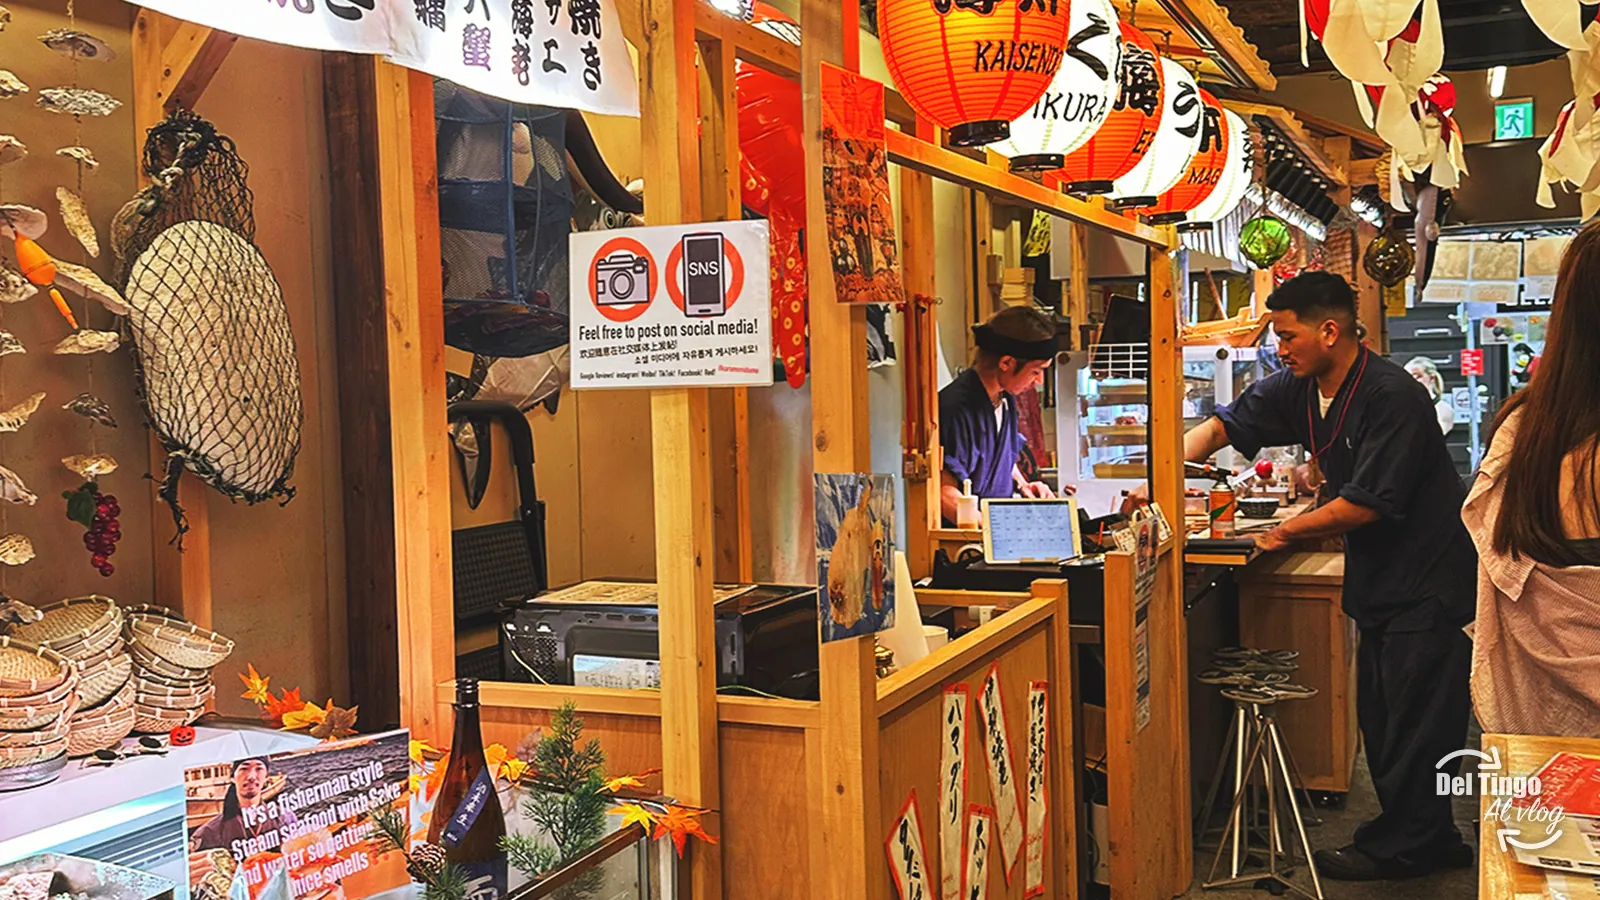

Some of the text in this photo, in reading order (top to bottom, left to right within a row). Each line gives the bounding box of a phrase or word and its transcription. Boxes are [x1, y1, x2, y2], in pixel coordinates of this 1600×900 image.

[688, 261, 719, 276] SNS
[579, 318, 758, 342] Feel free to post on social media!
[634, 354, 649, 365] 소셜
[947, 698, 963, 826] ハマグリ
[242, 759, 385, 829] It's a fisherman style
[231, 830, 281, 863] Steam
[280, 806, 338, 846] seafood
[338, 793, 369, 822] with
[368, 781, 402, 808] Sake
[243, 861, 263, 886] nd
[308, 842, 324, 862] so
[292, 851, 369, 898] nice smells
